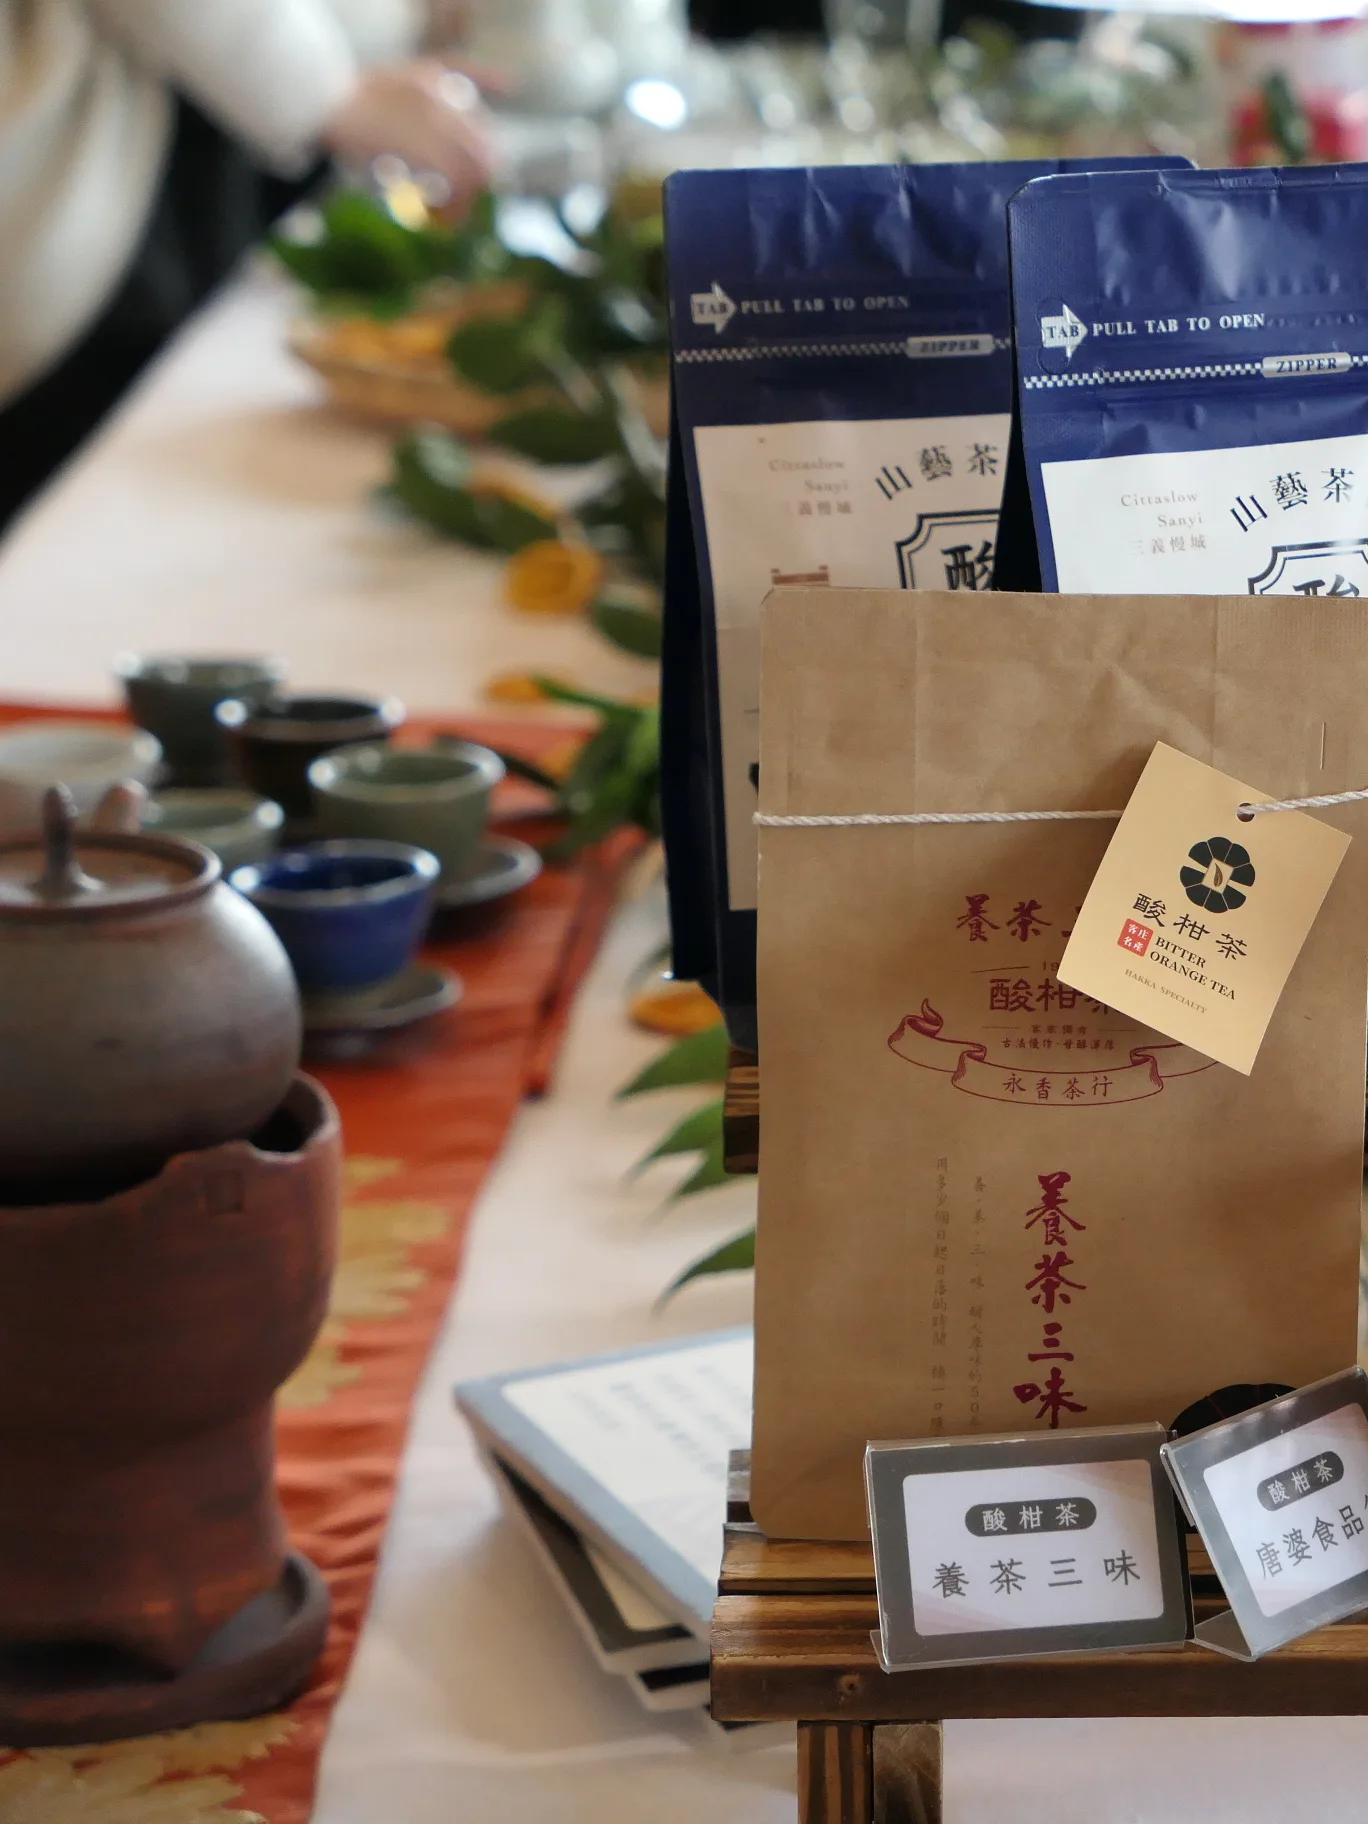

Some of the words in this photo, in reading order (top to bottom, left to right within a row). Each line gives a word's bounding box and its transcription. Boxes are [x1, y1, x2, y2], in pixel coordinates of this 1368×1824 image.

[741, 300, 784, 314] PULL
[794, 299, 825, 312] TAB
[834, 297, 855, 311] TO
[864, 296, 909, 309] OPEN
[1047, 326, 1080, 339] TAB
[1092, 321, 1137, 336] PULL
[1145, 318, 1178, 333] TAB
[1186, 317, 1211, 332] TO
[1219, 313, 1266, 329] OPEN
[919, 338, 981, 352] ZIPPER
[1275, 356, 1338, 374] ZIPPER
[804, 479, 850, 493] Sanyi
[875, 443, 999, 501] 山藝茶
[1120, 489, 1199, 508] Cittaslow
[1157, 514, 1204, 529] Sanyi
[1129, 533, 1207, 555] 三義慢城
[956, 893, 1082, 943] 養茶
[1132, 893, 1248, 961] 酸柑茶
[1156, 936, 1206, 968] BITTER
[1124, 968, 1157, 990] HAKKA
[1159, 985, 1208, 1014] SPECIALTY
[1149, 950, 1207, 987] ORANGE
[1210, 979, 1237, 1001] TEA
[1002, 1071, 1114, 1101] 永香茶行
[1012, 1170, 1088, 1431] 養茶三味
[1266, 1457, 1335, 1506] 酸柑茶
[981, 1501, 1081, 1533] 酸柑茶
[931, 1548, 1142, 1600] 養茶三味
